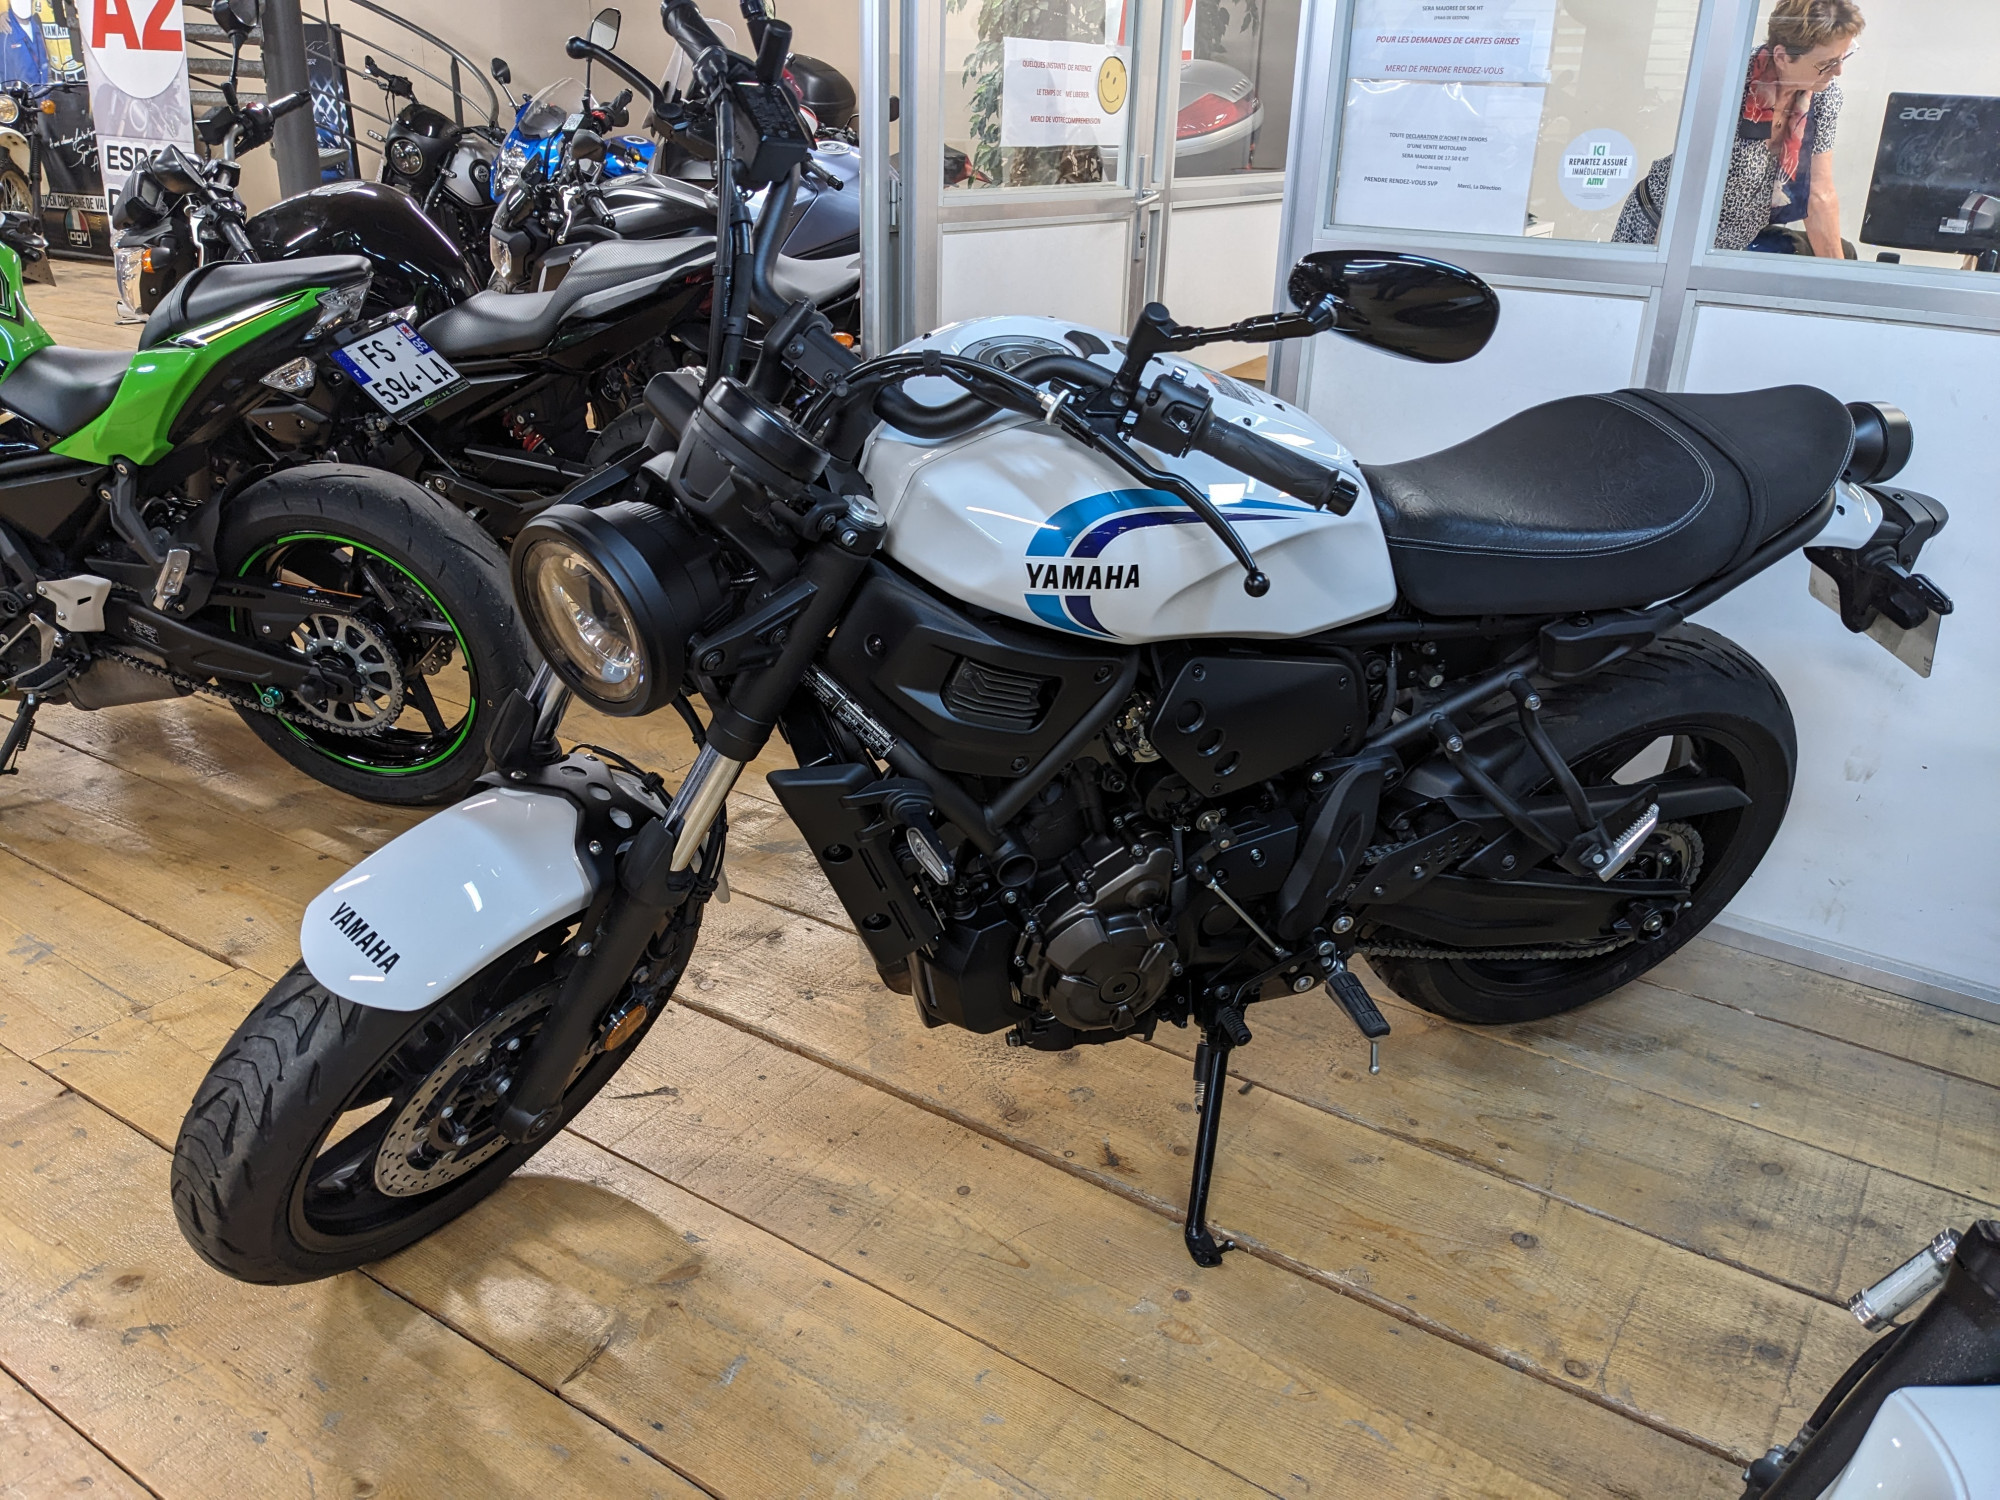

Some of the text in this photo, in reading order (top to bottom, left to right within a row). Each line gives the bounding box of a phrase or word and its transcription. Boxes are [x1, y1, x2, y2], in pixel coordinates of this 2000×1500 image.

[1397, 36, 1410, 44] LES
[1410, 36, 1452, 44] DEMANDES
[1022, 60, 1046, 68] QUELQUES
[1074, 64, 1092, 72] PATIENCE
[1384, 64, 1407, 72] MERCI
[1419, 66, 1452, 74] PRENDRE
[1453, 66, 1504, 74] RENDEZ-VOUS
[1036, 88, 1042, 96] LE
[1042, 88, 1056, 96] TEMPS
[1900, 107, 1951, 121] acer
[1593, 145, 1606, 156] ICI
[1568, 157, 1628, 166] REPARTEZ ASSURÉ
[1572, 167, 1618, 176] IMMÉDIATEMENT
[1389, 178, 1427, 186] RENDEZ-VOUS
[86, 197, 94, 210] DE
[70, 232, 88, 244] agv
[1026, 563, 1140, 590] YAMAHA
[329, 901, 401, 975] YAMAHA
